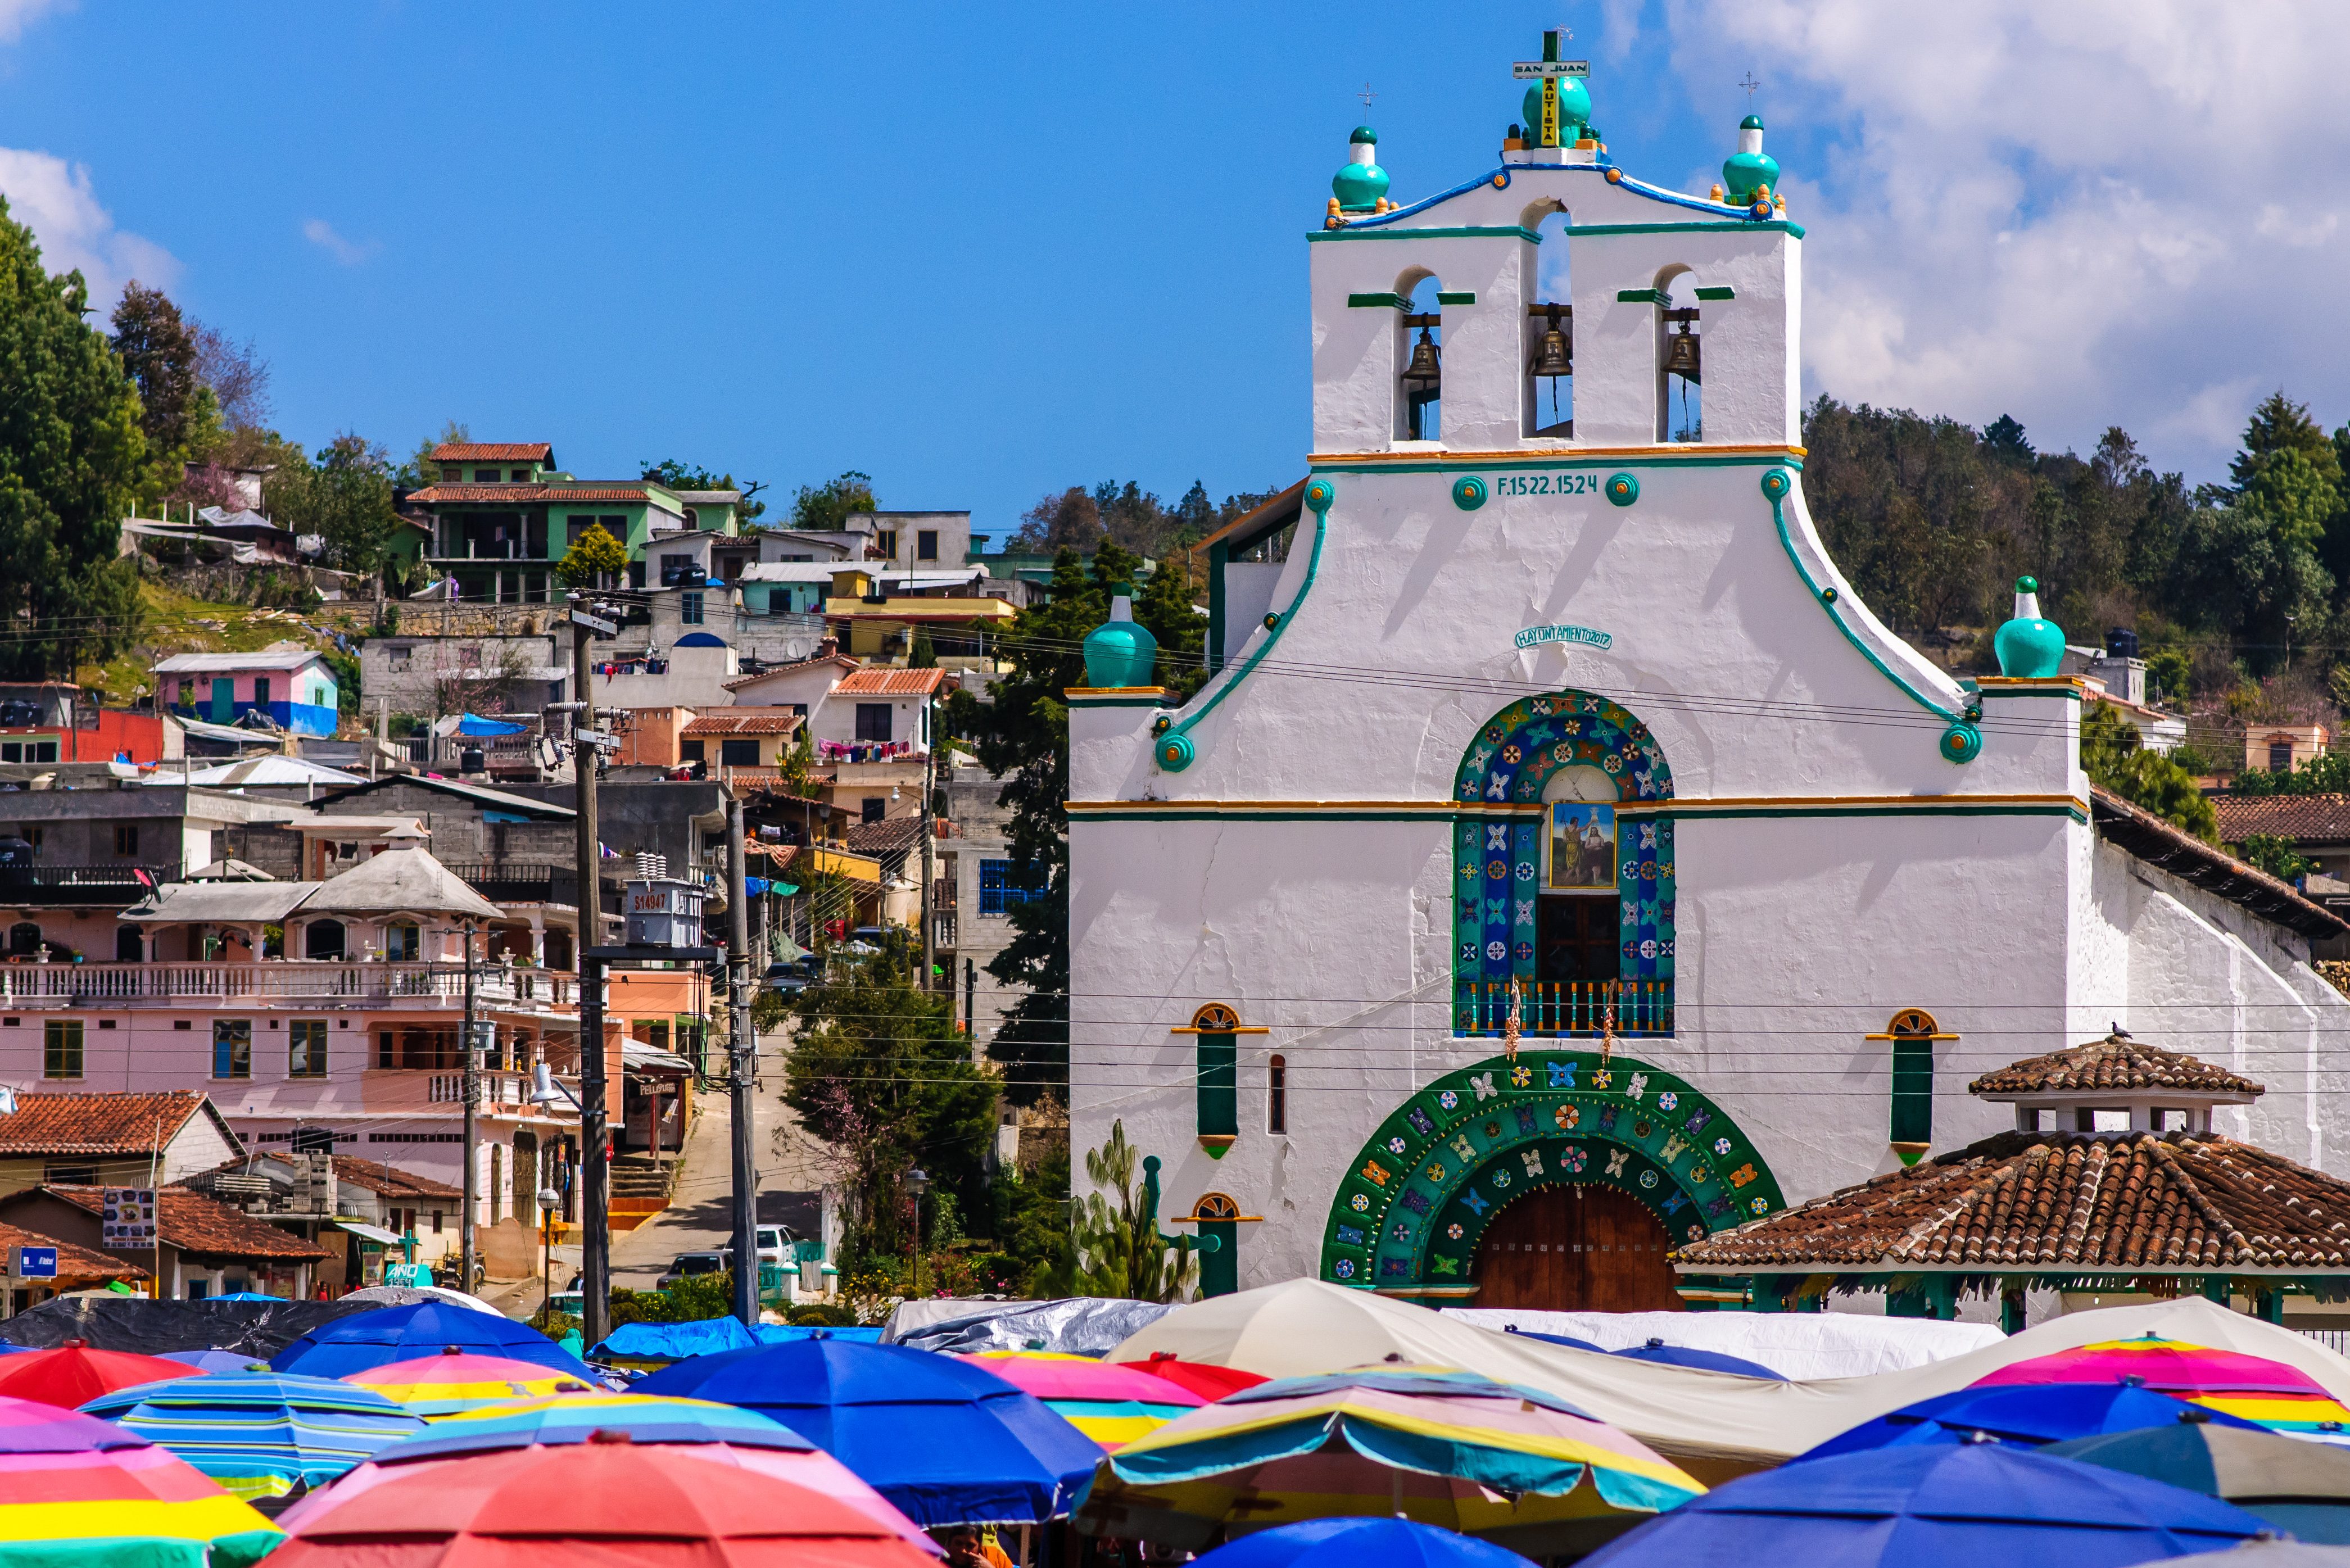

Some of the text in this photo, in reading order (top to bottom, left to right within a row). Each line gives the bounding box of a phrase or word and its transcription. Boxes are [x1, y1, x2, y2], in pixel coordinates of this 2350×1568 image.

[1544, 78, 1555, 141] BAUTISTA
[1498, 475, 1597, 496] F.1522.1524
[635, 894, 665, 910] S14947
